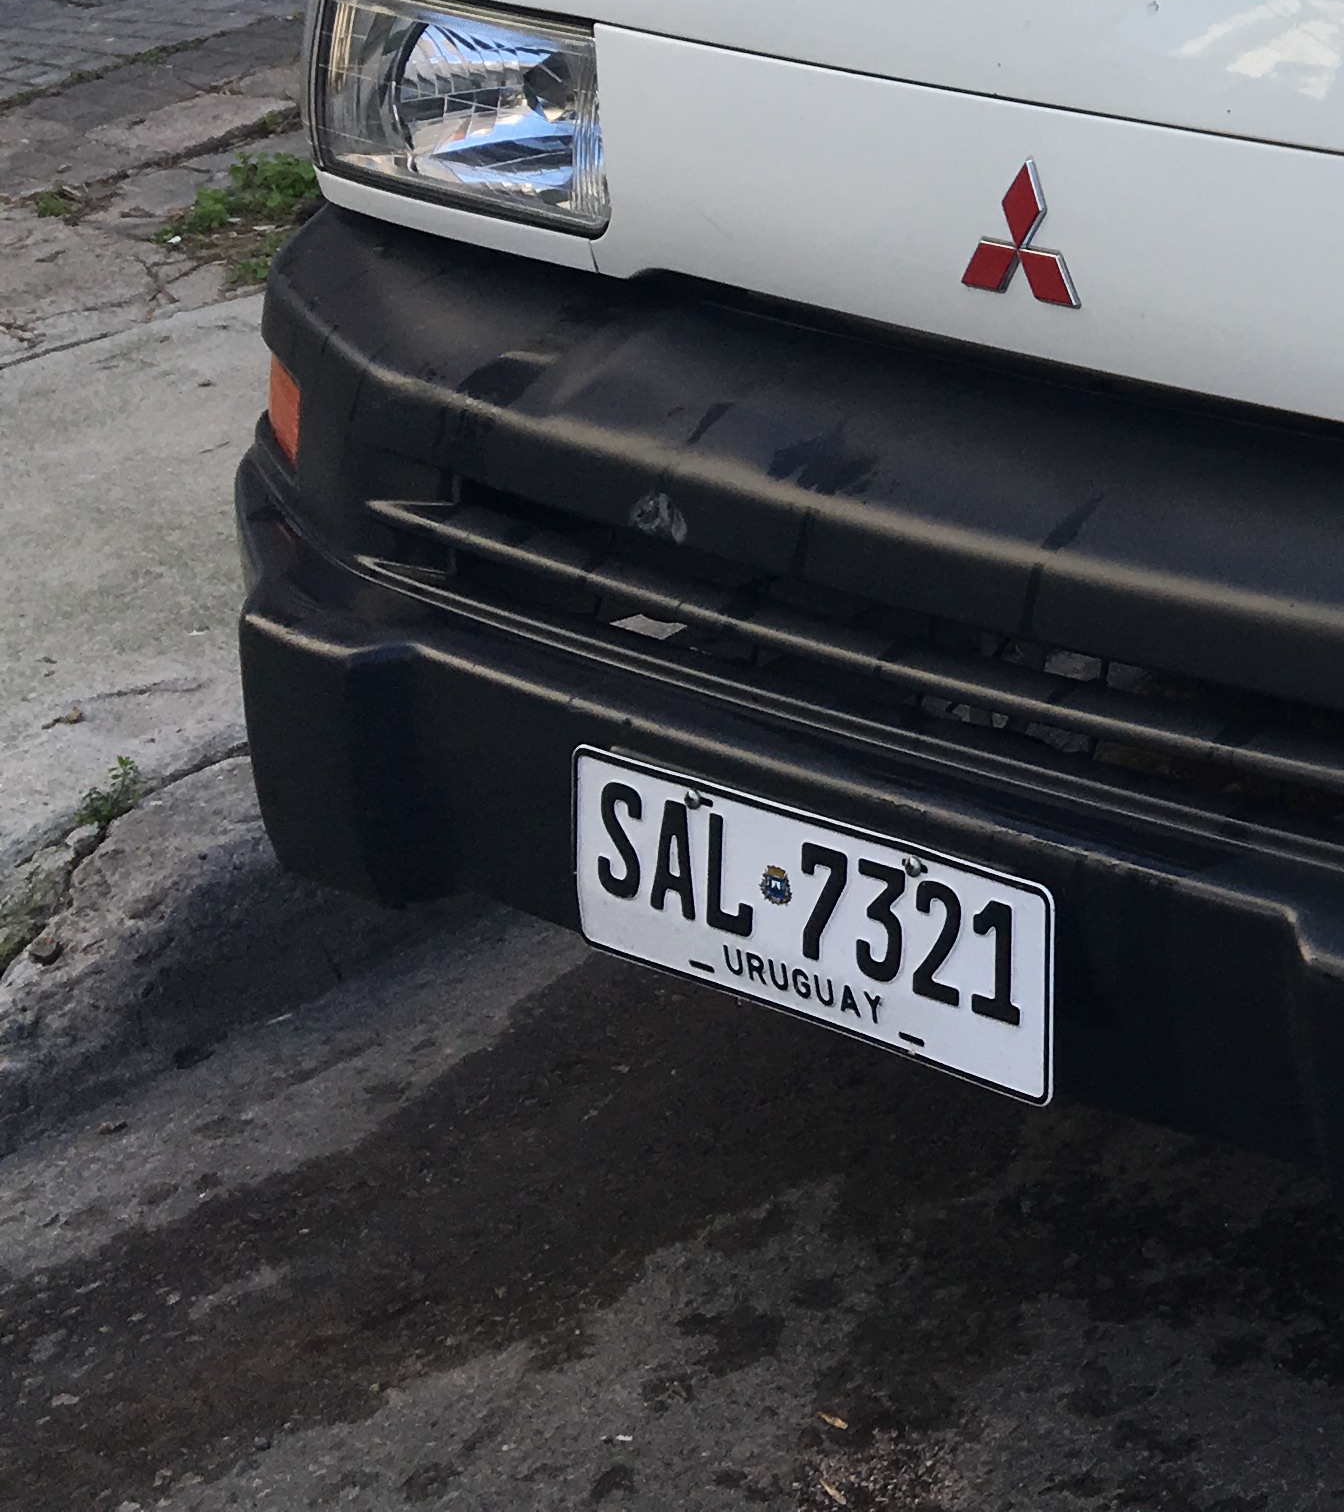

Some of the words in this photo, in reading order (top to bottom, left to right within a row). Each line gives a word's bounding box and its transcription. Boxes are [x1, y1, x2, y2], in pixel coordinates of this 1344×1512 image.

[597, 780, 754, 938] SAL
[800, 841, 1022, 1027] 7321
[722, 944, 884, 1024] URUGUAY
